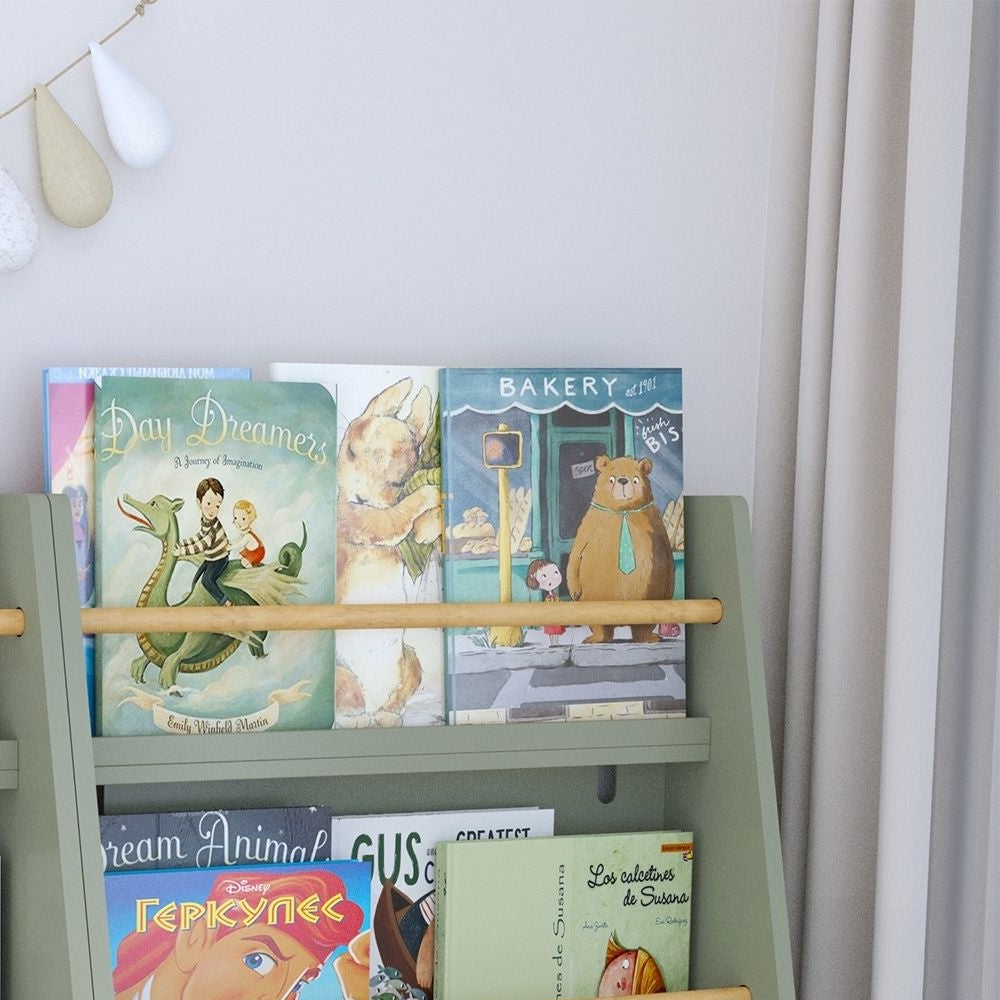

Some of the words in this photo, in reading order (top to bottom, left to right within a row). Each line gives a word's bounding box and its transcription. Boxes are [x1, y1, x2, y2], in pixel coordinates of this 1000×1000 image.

[500, 376, 618, 397] BAKERY
[638, 376, 657, 396] 1901
[101, 398, 172, 461] Day
[186, 389, 329, 465] Dreamers
[641, 417, 672, 440] fresh
[645, 426, 681, 454] BIS
[184, 454, 212, 470] Journey
[212, 455, 221, 465] of
[222, 453, 264, 471] Imagination
[167, 714, 192, 735] Emily
[194, 719, 234, 735] Winfield
[236, 717, 269, 734] Martin
[195, 810, 330, 868] Animal
[350, 831, 422, 887] GUS
[587, 863, 618, 889] Los
[620, 864, 675, 884] calcetines
[552, 864, 565, 938] Susana
[623, 888, 638, 906] de
[640, 885, 690, 907] Susana
[135, 893, 346, 933] ГЕРКУЛЕС
[552, 943, 563, 967] de
